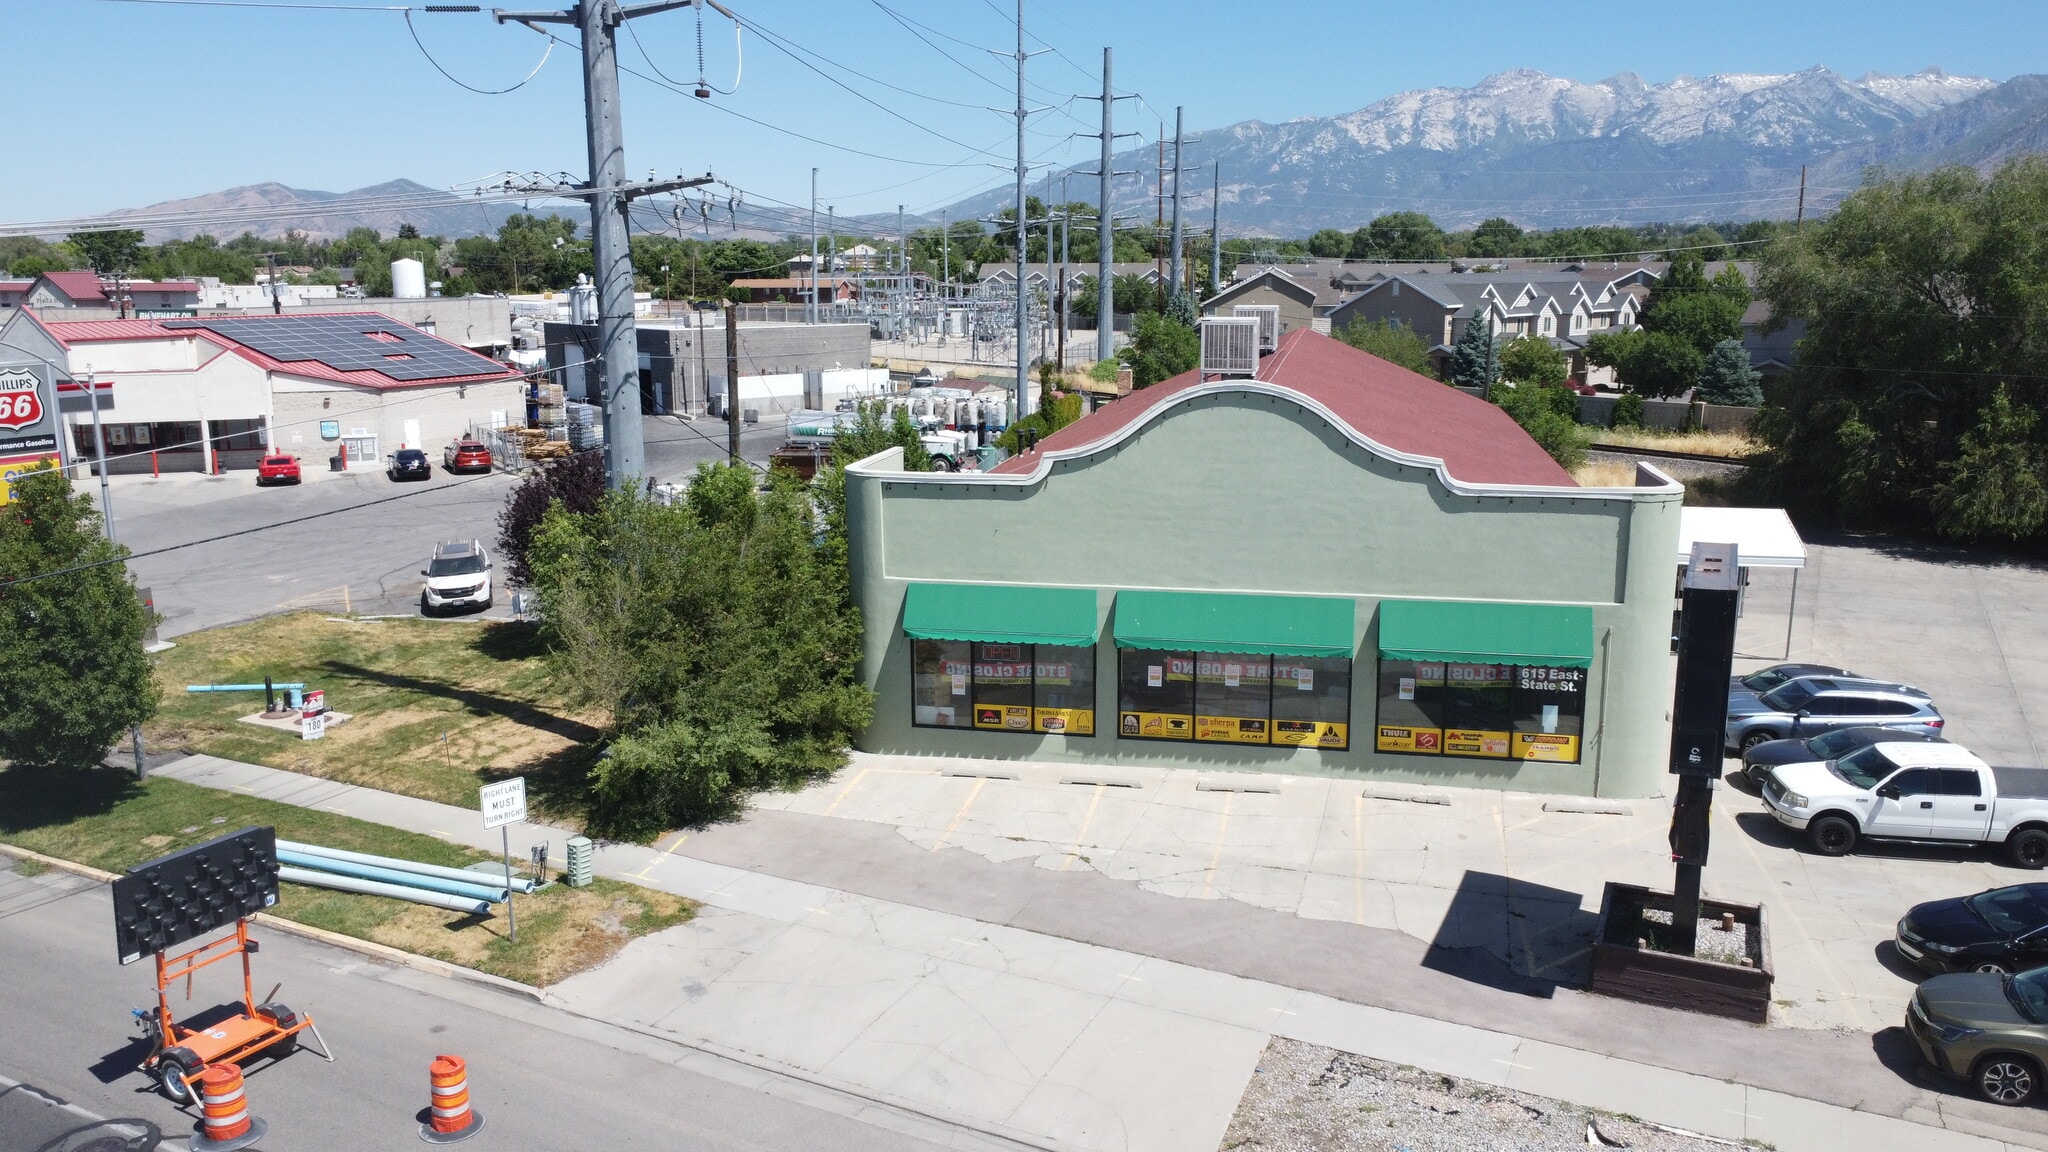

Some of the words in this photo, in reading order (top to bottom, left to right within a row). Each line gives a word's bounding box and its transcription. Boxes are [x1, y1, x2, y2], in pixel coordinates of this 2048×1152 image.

[0, 378, 33, 391] ILLIPS
[0, 394, 32, 419] 66
[25, 438, 54, 447] Gasoline
[984, 646, 1020, 658] OPEN
[1521, 668, 1546, 679] 615
[1521, 679, 1556, 690] State
[1560, 680, 1578, 692] St.
[1209, 718, 1235, 727] sherpa
[1382, 729, 1409, 737] THULE
[483, 788, 504, 799] RIGHT
[505, 783, 521, 794] LANE
[492, 797, 515, 810] MUST
[485, 813, 503, 824] TURN
[504, 808, 524, 819] RIGHT
